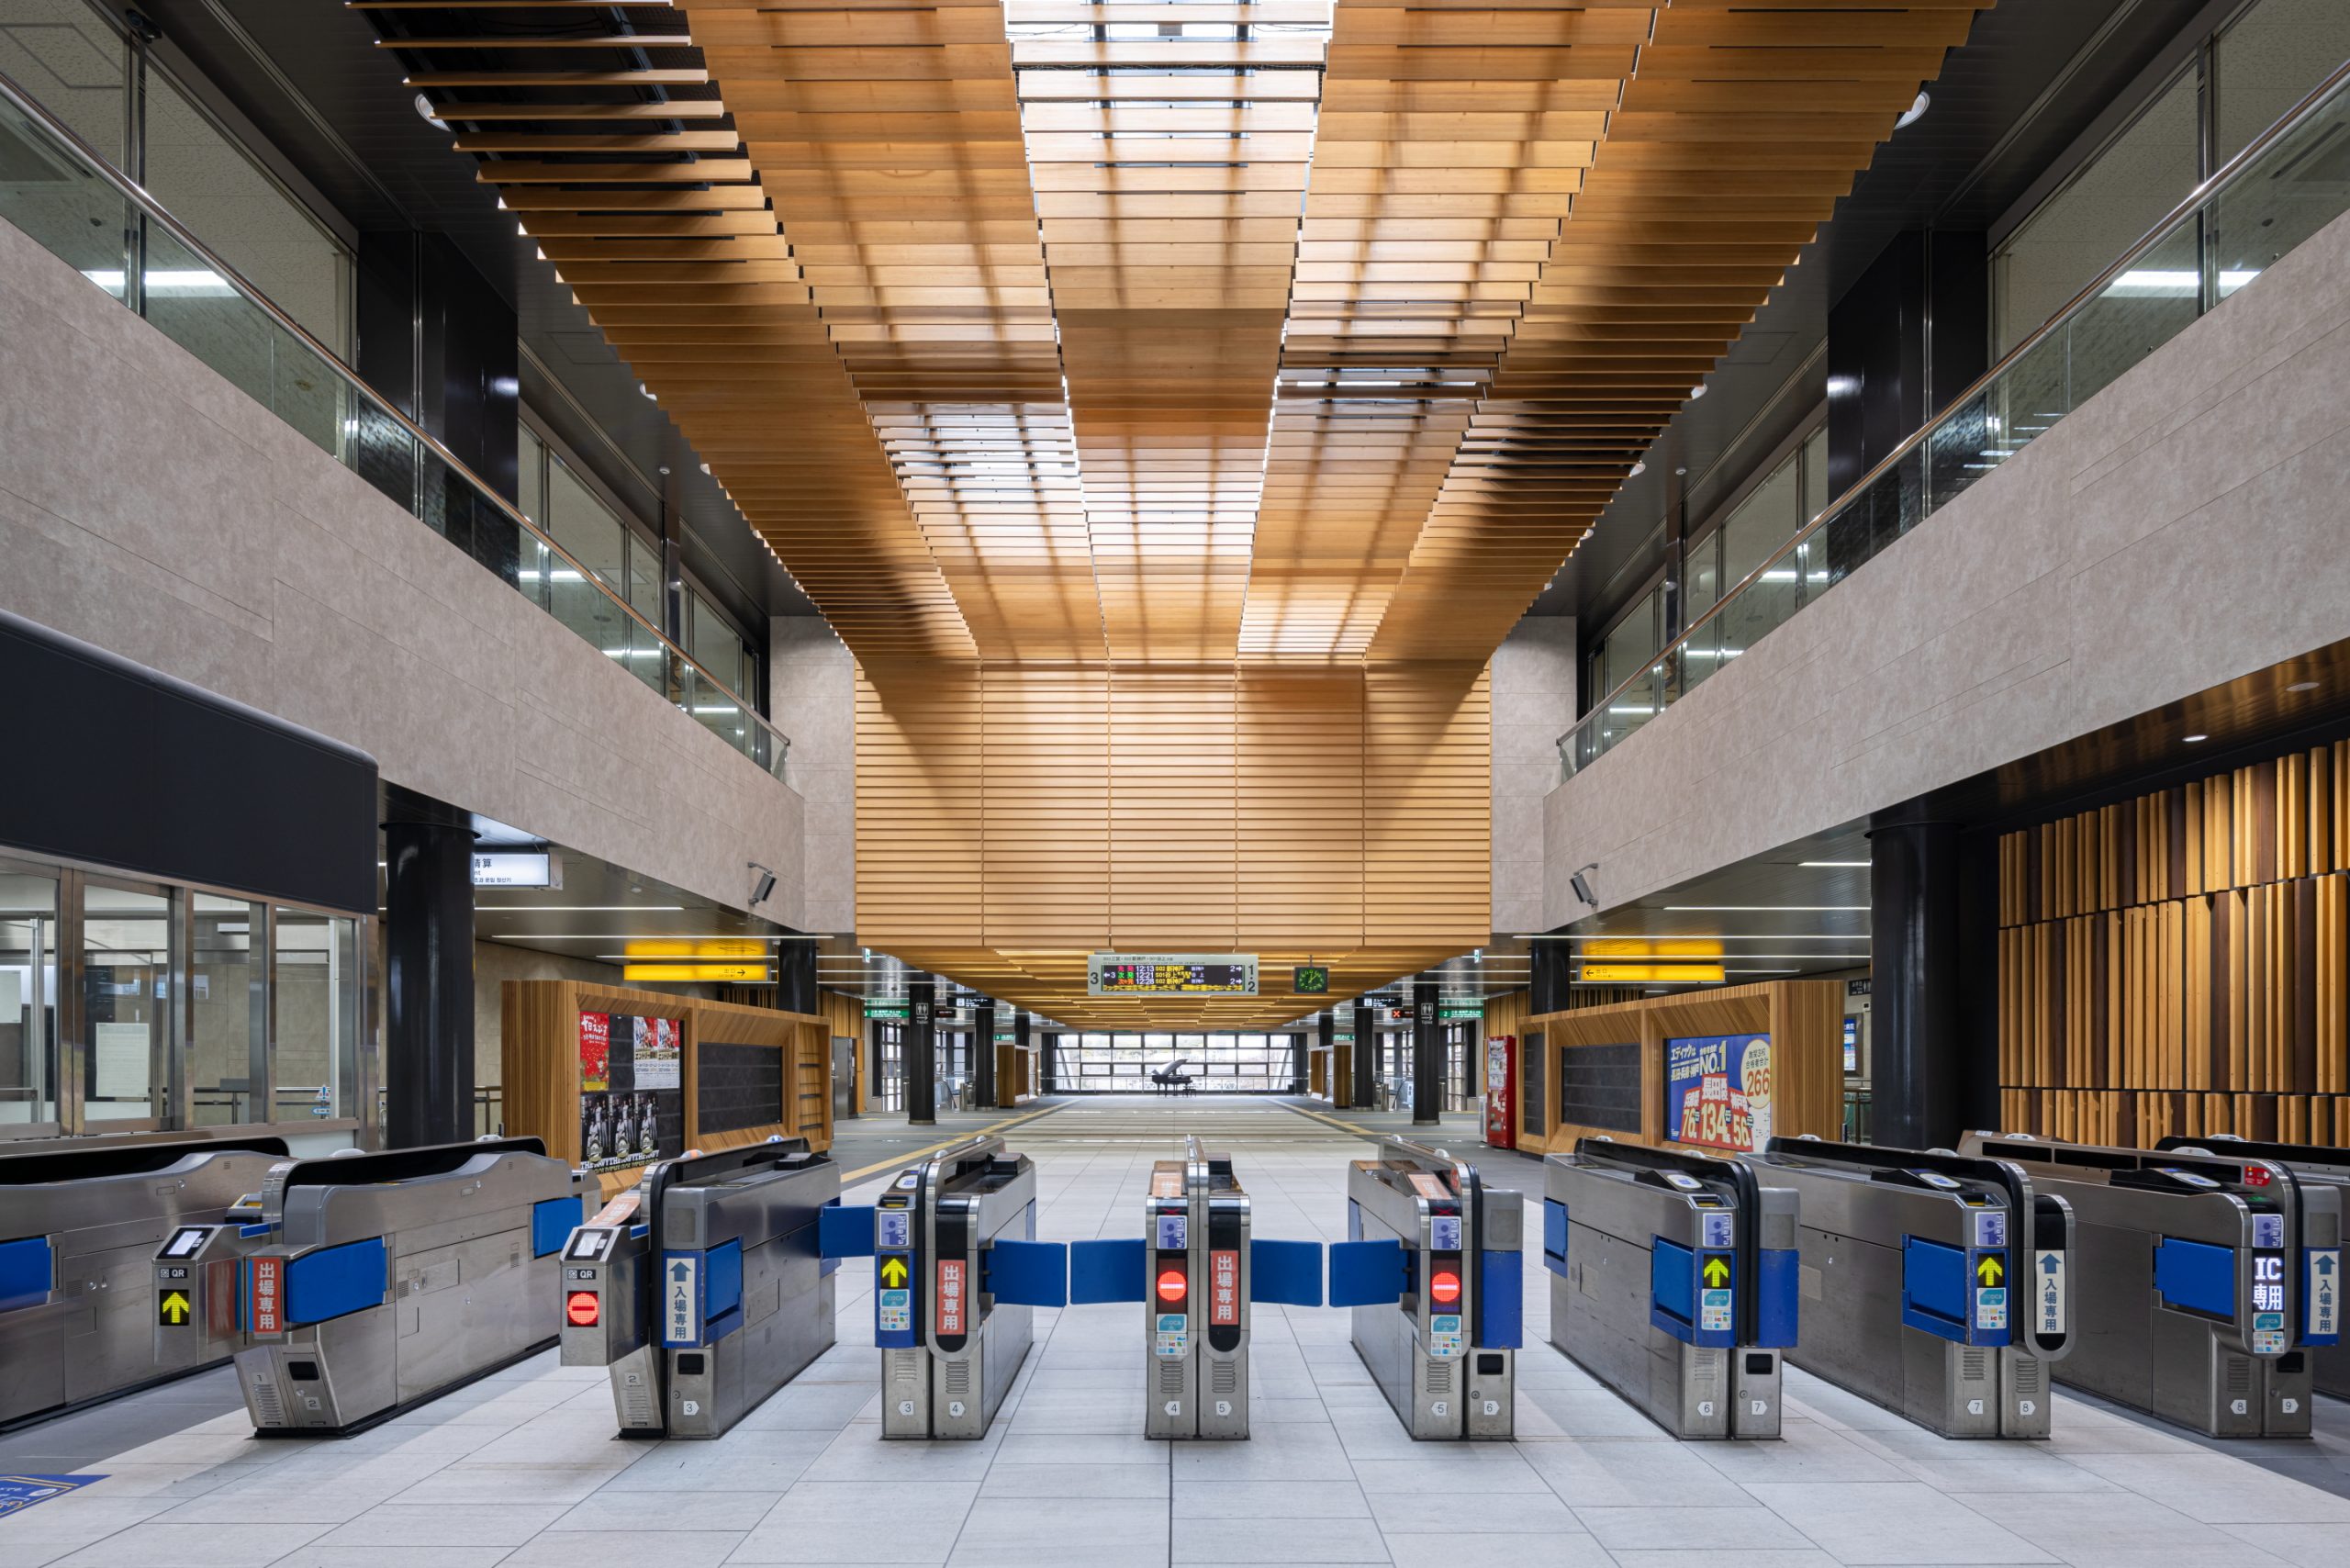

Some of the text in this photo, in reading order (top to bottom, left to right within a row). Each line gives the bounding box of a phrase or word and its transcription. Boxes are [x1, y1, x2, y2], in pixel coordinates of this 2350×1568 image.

[1091, 972, 1099, 984] 3
[1699, 1040, 1727, 1076] NO.1
[1747, 1068, 1770, 1097] 266
[898, 1215, 906, 1245] PiTaPa
[1176, 1218, 1184, 1248] PiTaPa
[1449, 1219, 1459, 1249] PiTaPa
[1723, 1215, 1731, 1246] PiTaPa
[2271, 1215, 2280, 1247] PiTaPa
[172, 1269, 185, 1277] QR
[580, 1270, 593, 1279] QR
[2254, 1257, 2282, 1281] IC
[1216, 1255, 1233, 1321] 出場専用
[258, 1262, 274, 1330] 出場専用
[943, 1264, 959, 1330] 出場専用
[2253, 1284, 2283, 1311] 専用
[2044, 1278, 2057, 1331] 入場専用
[2319, 1279, 2333, 1333] 入場専用
[674, 1286, 687, 1339] 入場専用
[686, 1403, 692, 1413] 3
[904, 1403, 912, 1412] 3
[952, 1404, 958, 1413] 4
[1170, 1404, 1177, 1413] 4
[1219, 1404, 1225, 1413] 5
[1438, 1404, 1444, 1414] 5
[1486, 1403, 1493, 1412] 6
[1704, 1404, 1710, 1413] 6
[1754, 1403, 1761, 1412] 7
[1974, 1402, 1980, 1411] 7
[2022, 1403, 2029, 1412] 8
[2237, 1402, 2244, 1411] 8
[2286, 1401, 2292, 1410] 9
